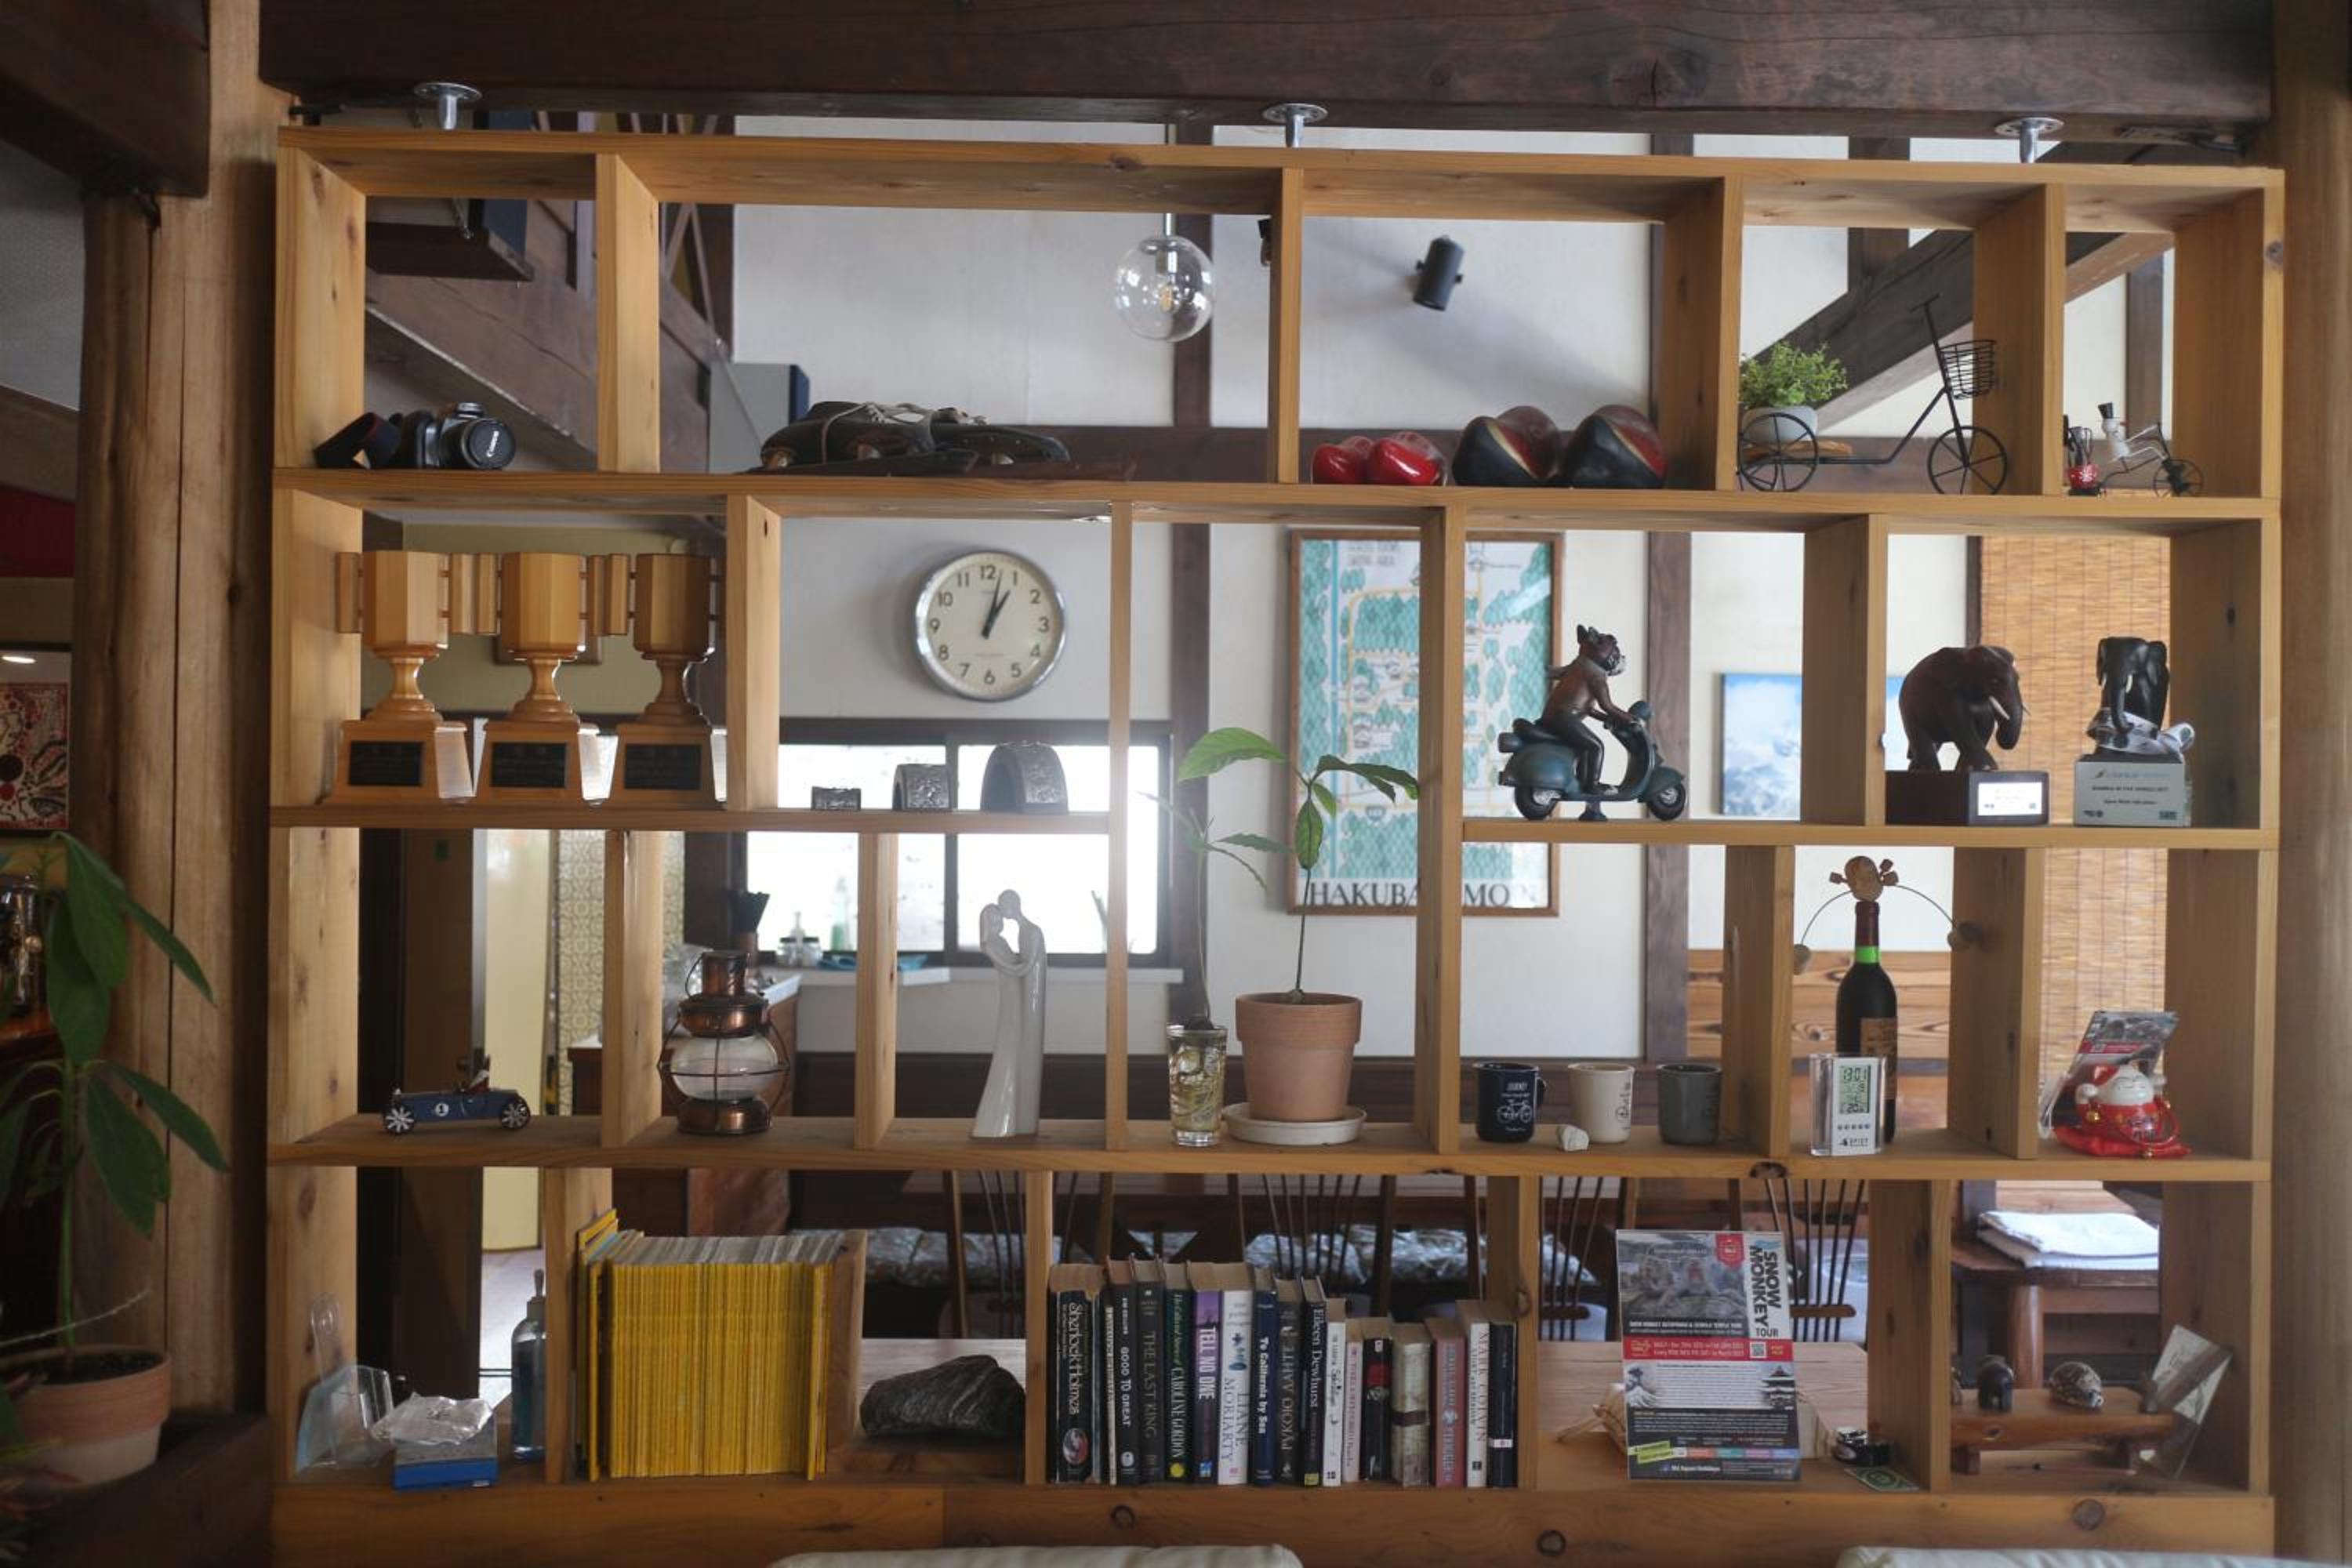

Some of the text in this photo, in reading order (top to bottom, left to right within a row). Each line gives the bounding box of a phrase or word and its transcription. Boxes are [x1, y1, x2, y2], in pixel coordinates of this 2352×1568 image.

[957, 572, 970, 586] 11
[980, 564, 996, 579] 12
[1012, 570, 1018, 586] 1
[938, 591, 953, 607] 10
[1030, 590, 1041, 604] 2
[929, 618, 940, 633] 9
[1038, 616, 1050, 633] 3
[938, 644, 949, 660] 8
[1030, 644, 1041, 658] 4
[960, 662, 971, 677] 7
[984, 670, 996, 684] 6
[1011, 662, 1022, 677] 5
[1750, 1245, 1769, 1330] MONKEY
[1764, 1250, 1782, 1309] SNOW
[1069, 1302, 1083, 1363] Sherlock
[1312, 1308, 1324, 1345] Eileen
[1755, 1327, 1780, 1338] TOUR
[1199, 1326, 1216, 1354] TELL
[1259, 1336, 1269, 1350] To
[1199, 1356, 1216, 1373] NO
[1143, 1333, 1157, 1439] THE LAST KING
[1310, 1349, 1323, 1407] Dewhurst
[1120, 1346, 1131, 1427] GOOD TO GREAT
[1199, 1376, 1216, 1399] ONE
[1257, 1401, 1268, 1413] by
[1221, 1377, 1236, 1461] MORIARTY
[1236, 1393, 1251, 1446] LIANE
[1258, 1415, 1268, 1434] Sea
